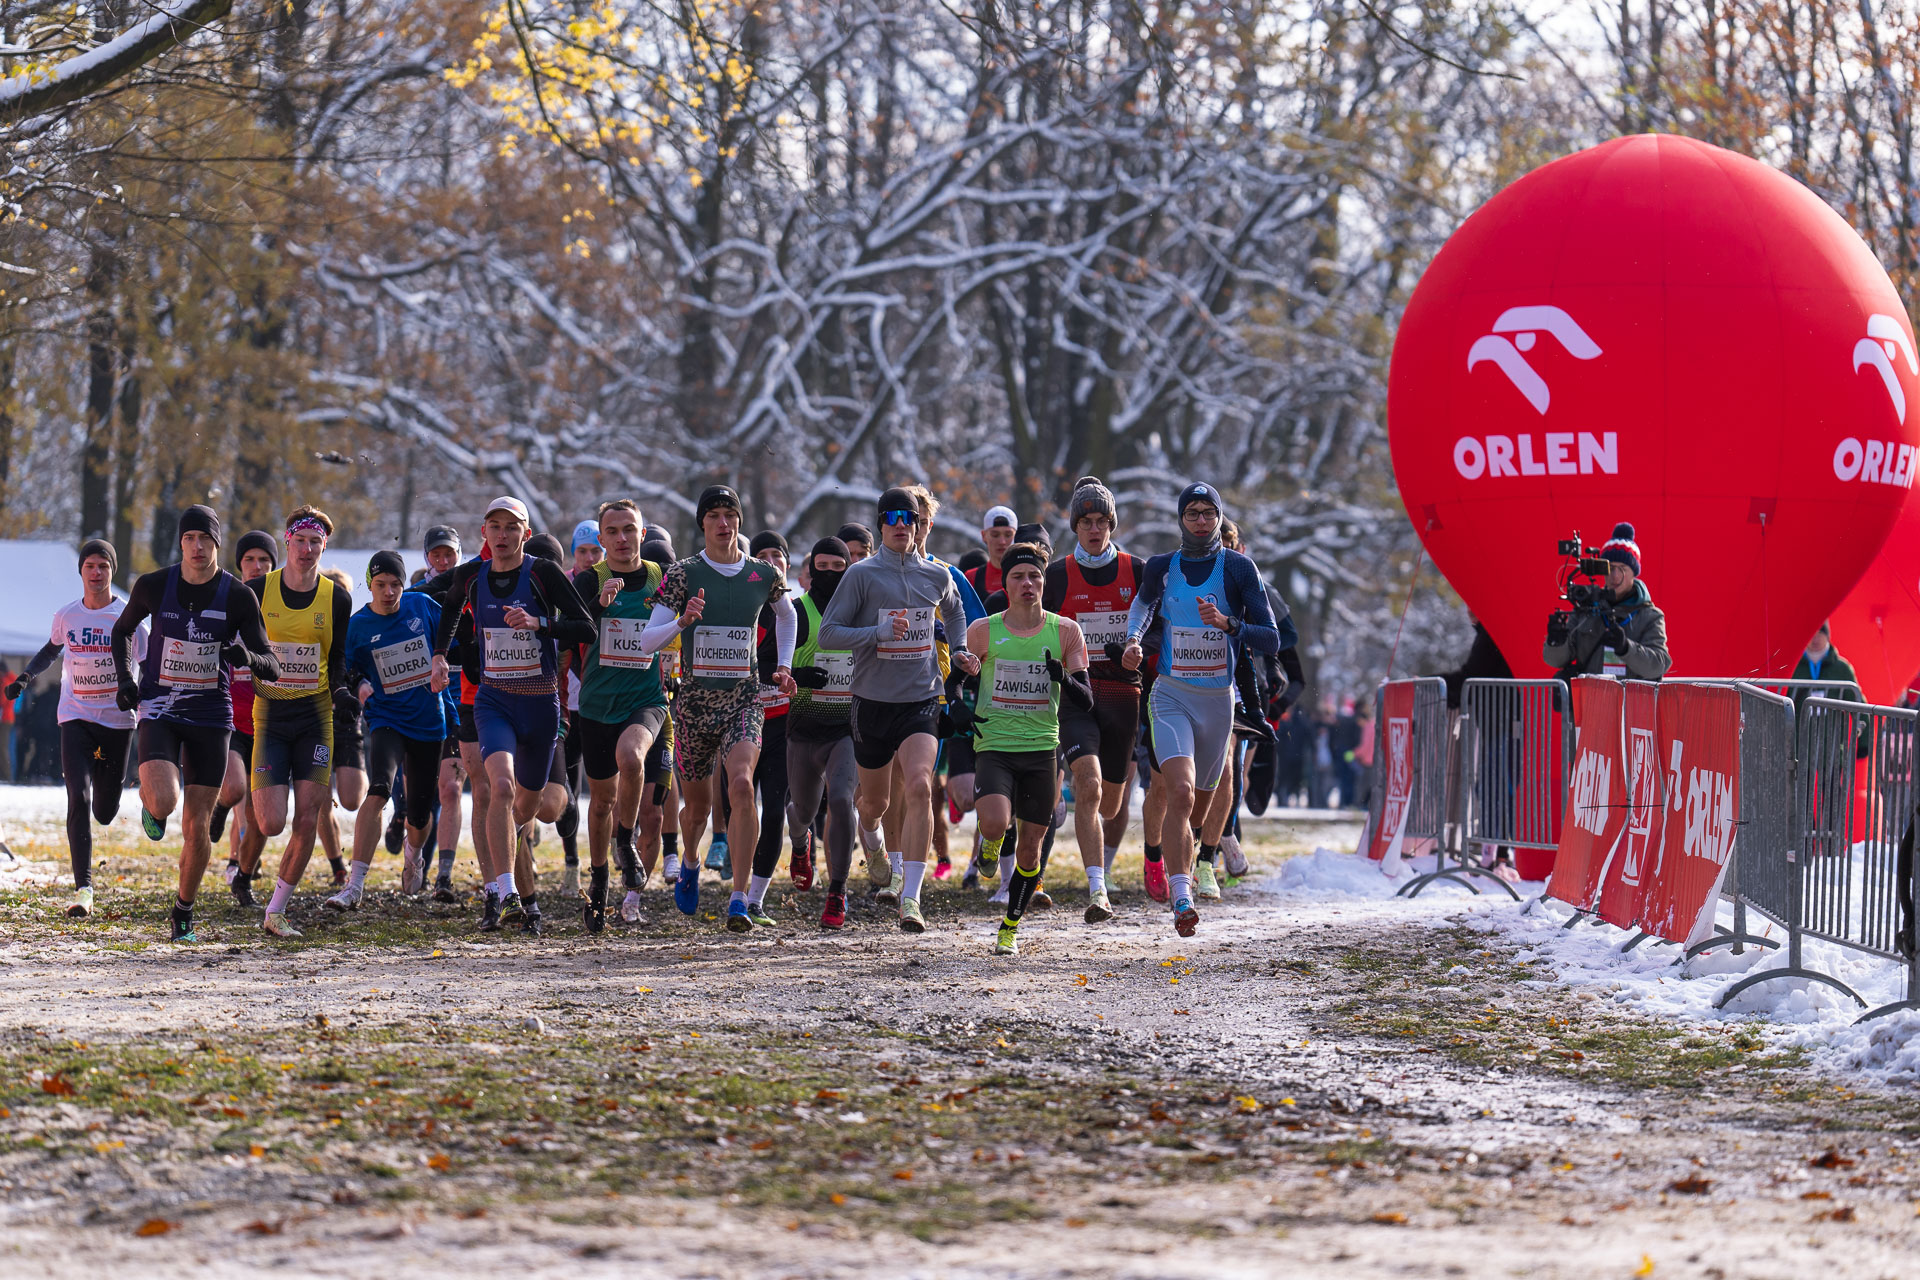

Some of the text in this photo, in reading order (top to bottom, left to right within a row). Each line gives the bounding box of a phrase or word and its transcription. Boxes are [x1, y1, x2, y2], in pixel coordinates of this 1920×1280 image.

[1453, 432, 1619, 480] ORLEN
[1833, 437, 1919, 490] ORLEN
[915, 611, 928, 621] 54
[1109, 614, 1128, 624] 559
[191, 632, 214, 640] MKL
[512, 631, 531, 641] 482
[727, 630, 747, 640] 402
[902, 628, 930, 641] OWSKI
[1202, 631, 1224, 641] 423
[197, 645, 216, 656] 122
[296, 647, 316, 656] 671
[404, 640, 424, 653] 628
[486, 648, 538, 660] MACHULEC
[696, 647, 749, 660] KUCHERENKO
[1173, 648, 1226, 660] NURKOWSKI
[94, 658, 113, 668] 543
[163, 659, 217, 674] CZERWONKA
[847, 656, 856, 667] 3
[1028, 664, 1048, 674] 157
[73, 672, 118, 685] WANGLORZ
[995, 680, 1049, 694] ZAWIŚLAK
[1684, 766, 1734, 866] ORLEN
